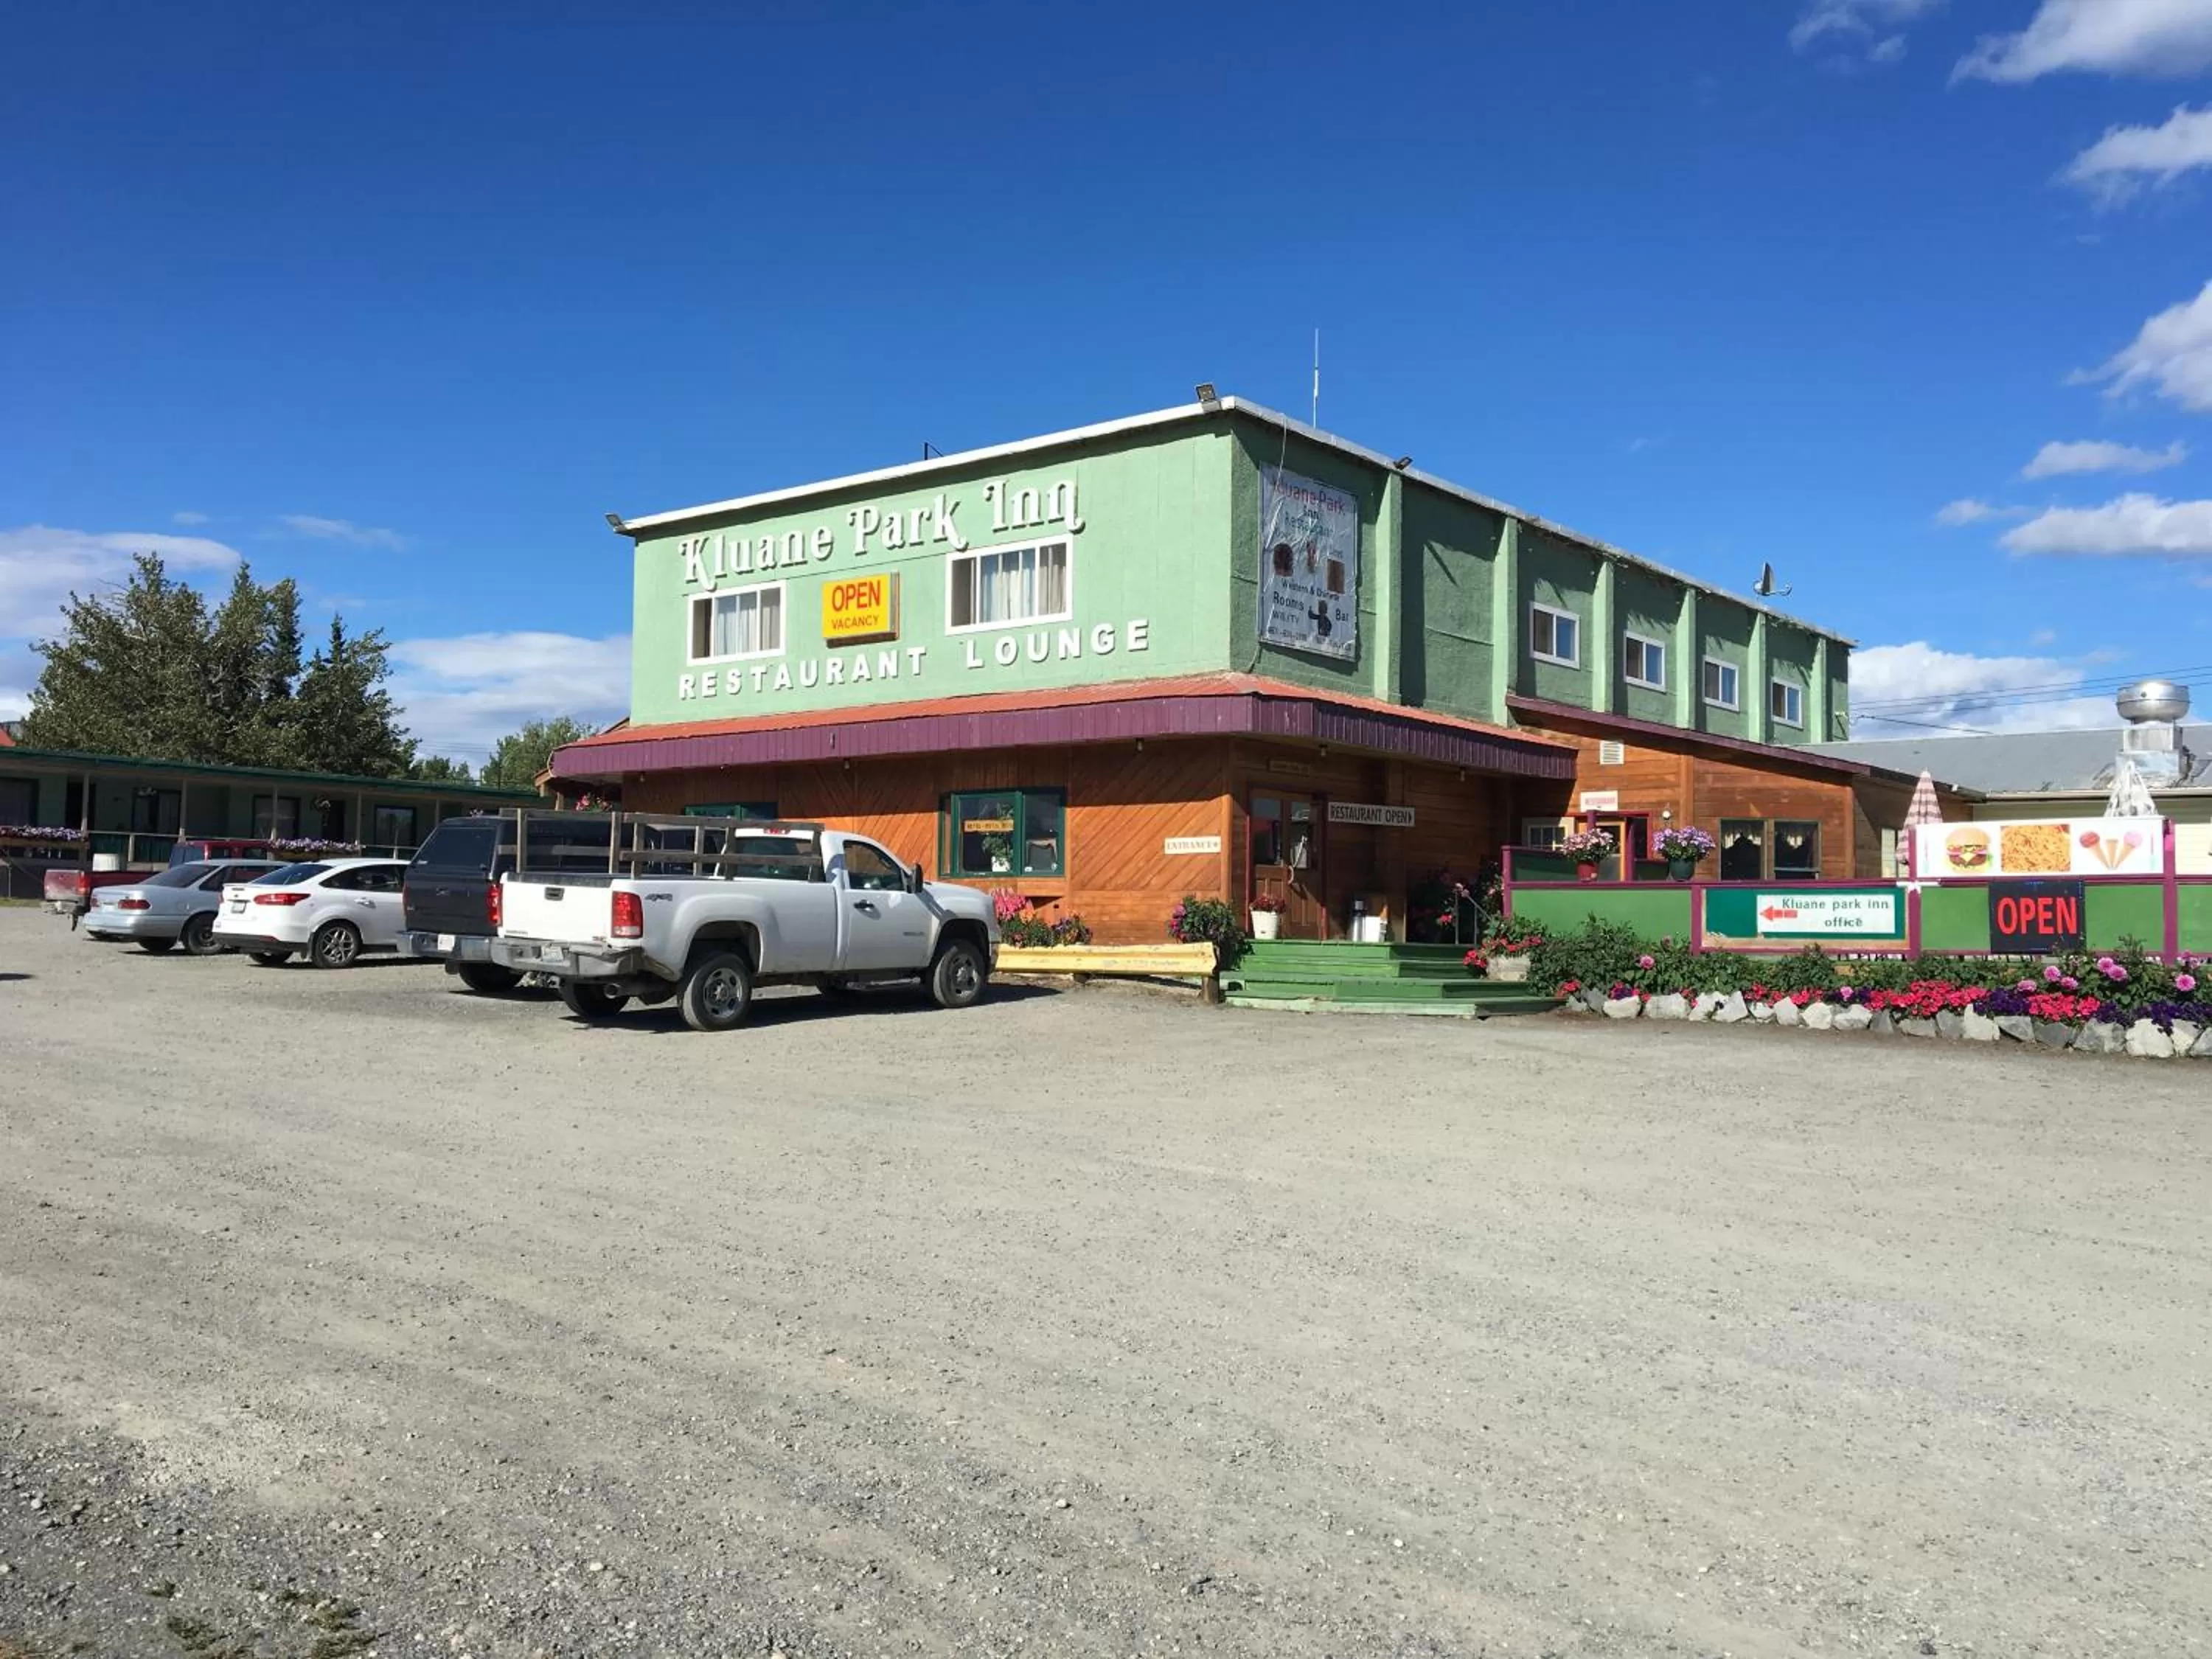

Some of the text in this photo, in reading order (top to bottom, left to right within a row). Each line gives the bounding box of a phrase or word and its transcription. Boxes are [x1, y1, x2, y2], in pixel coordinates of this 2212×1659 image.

[678, 479, 1085, 593] Kluane Park Inn
[832, 580, 880, 612] OPEN
[831, 615, 879, 630] VACANCY
[1335, 607, 1349, 622] Bar
[678, 617, 1150, 700] RESTAURANT LOUNGE
[1330, 804, 1408, 824] RESTAURANT OPEN
[1782, 898, 1889, 912] Kluane park inn
[1825, 917, 1863, 928] office
[1997, 896, 2077, 935] OPEN
